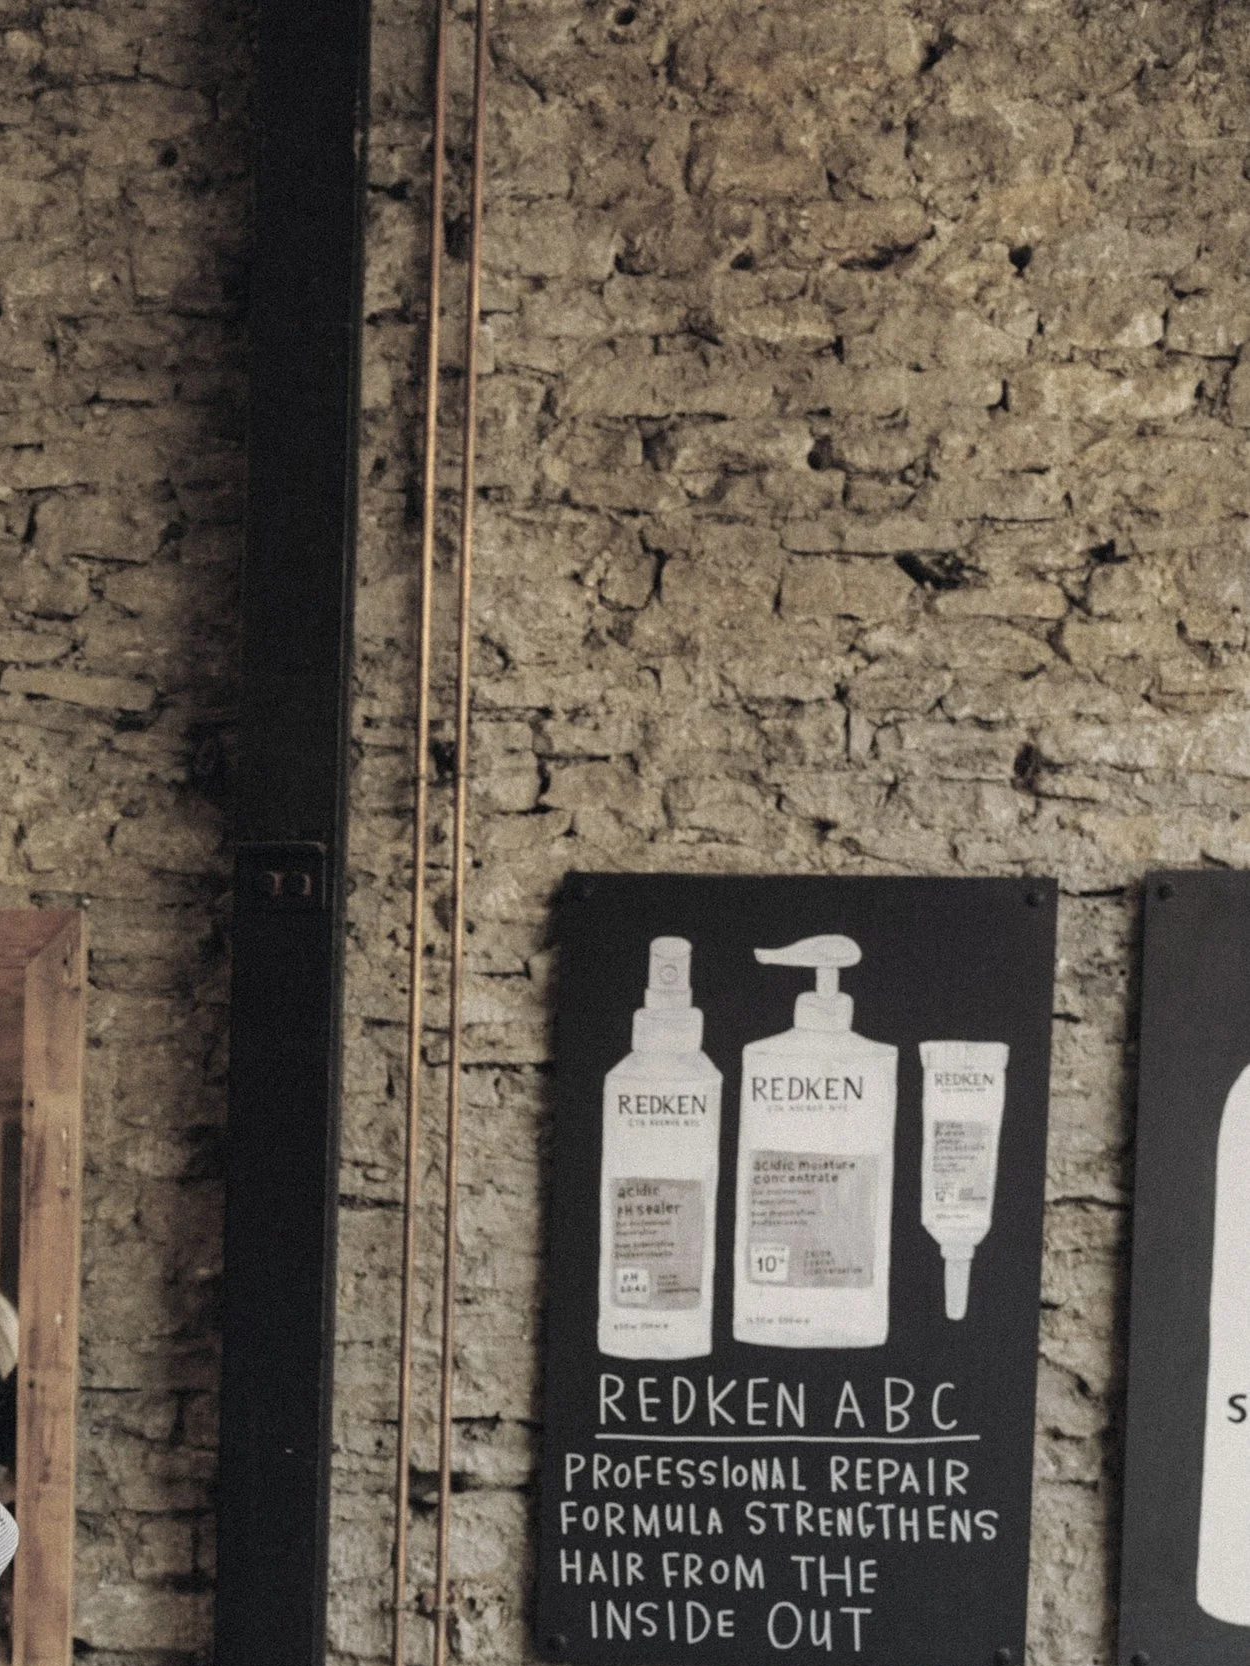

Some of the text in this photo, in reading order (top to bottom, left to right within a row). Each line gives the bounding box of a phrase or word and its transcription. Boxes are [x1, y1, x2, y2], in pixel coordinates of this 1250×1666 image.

[751, 1076, 864, 1102] REDKEN
[934, 1071, 995, 1087] REDKEN
[617, 1093, 707, 1116] REDKEN
[752, 1173, 840, 1186] concentrate
[798, 1159, 856, 1172] moisture
[599, 1373, 806, 1428] REDKEN
[564, 1452, 970, 1496] PROFESSIONAL REPAIR
[560, 1500, 1000, 1543] FORMULA STRENGTHENS
[559, 1548, 879, 1597] HAIR FROM THE
[590, 1599, 873, 1652] INSIDE OUT
